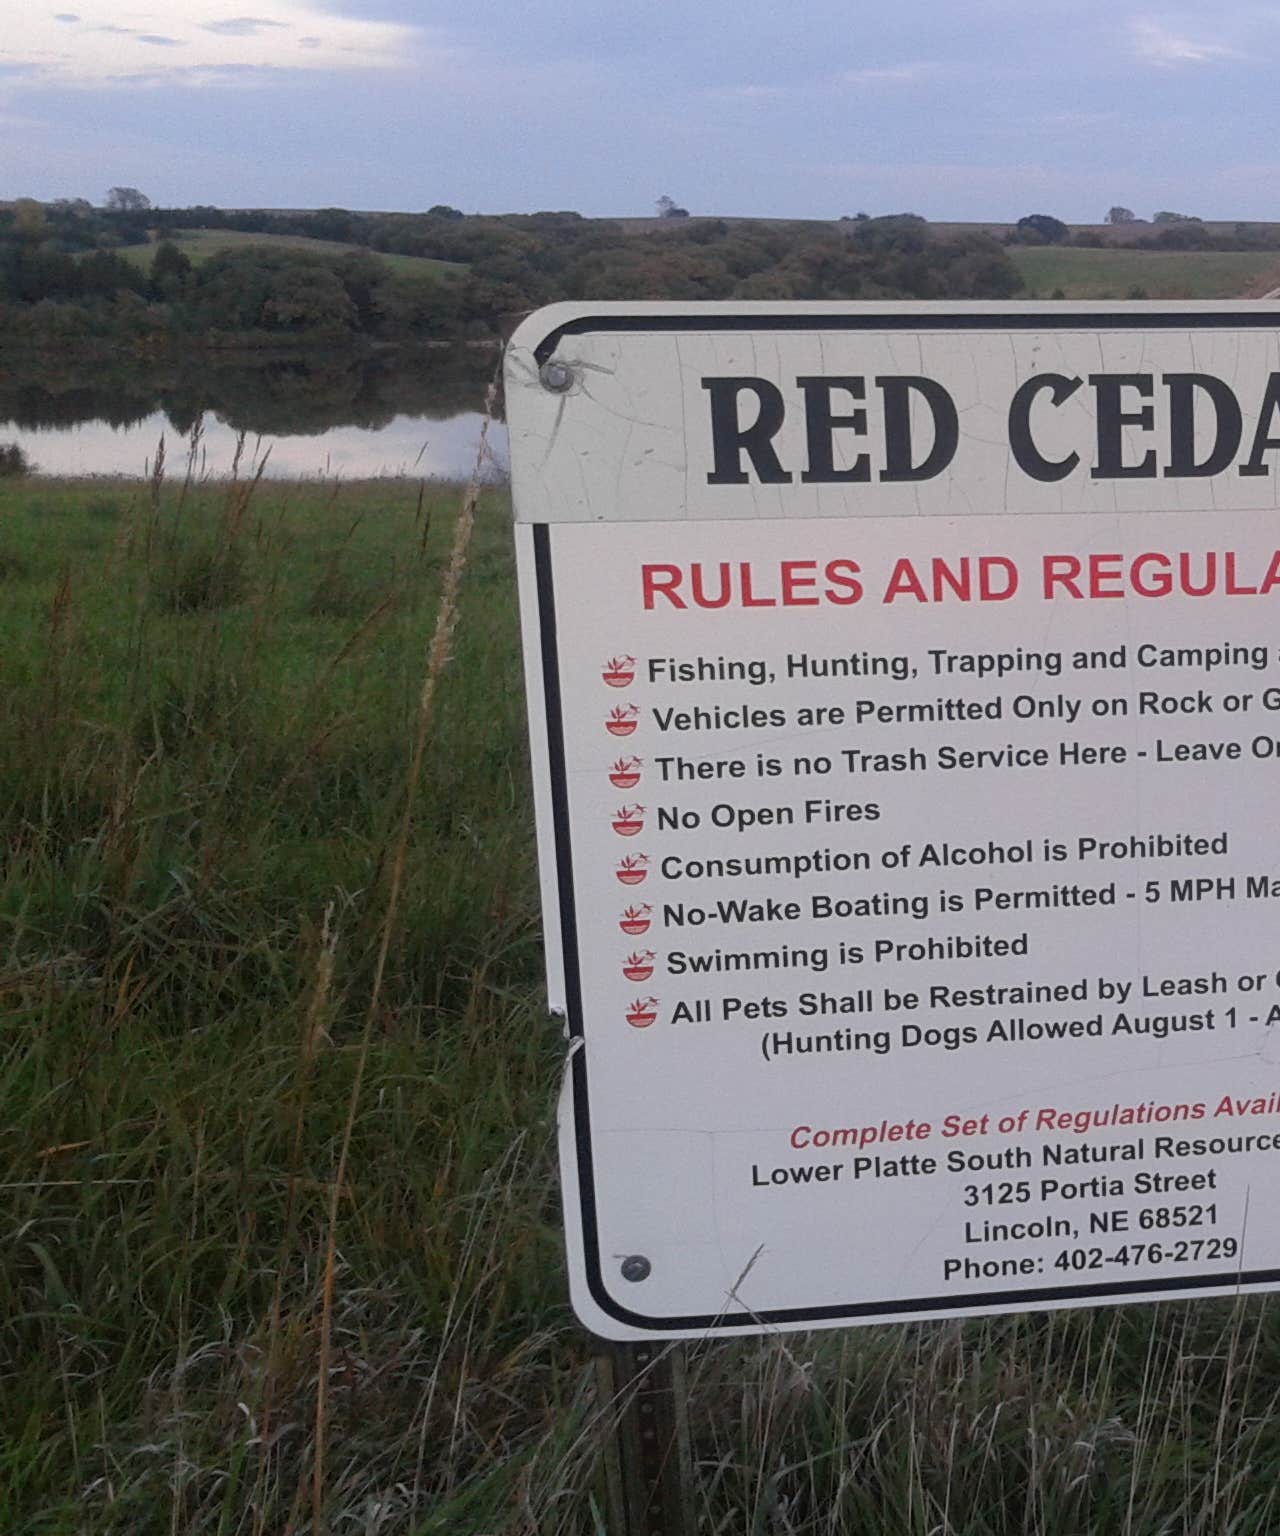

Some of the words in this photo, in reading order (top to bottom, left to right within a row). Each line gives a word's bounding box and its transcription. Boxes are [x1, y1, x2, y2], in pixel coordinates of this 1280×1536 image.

[700, 375, 960, 486] RED
[640, 558, 864, 611] RULES
[882, 556, 1019, 605] AND
[647, 655, 776, 686] Fishing,
[786, 650, 919, 681] Hunting,
[927, 646, 1063, 679] Trapping
[1071, 644, 1127, 670] and
[1136, 641, 1269, 673] Camping
[651, 703, 787, 732] Vehicles
[796, 706, 846, 727] are
[855, 695, 1003, 725] Permitted
[1012, 693, 1083, 724] Only
[1091, 697, 1129, 717] on
[1138, 689, 1214, 716] Rock
[1222, 693, 1254, 713] or
[653, 755, 747, 782] There
[756, 752, 783, 778] is
[793, 756, 833, 777] no
[840, 746, 928, 774] Trash
[937, 743, 1050, 770] Service
[1059, 741, 1128, 766] Here
[1155, 738, 1242, 763] Leave
[656, 805, 701, 832] No
[710, 803, 795, 833] Open
[803, 798, 881, 825] Fires
[660, 847, 871, 880] Consumption
[881, 843, 913, 869] of
[917, 839, 1033, 868] Alcohol
[1043, 838, 1069, 863] is
[1077, 831, 1228, 861] Prohibited
[663, 897, 802, 928] No-Wake
[811, 889, 929, 921] Boating
[938, 887, 965, 912] is
[973, 881, 1116, 913] Permitted
[1144, 880, 1161, 904] 5
[1170, 876, 1236, 903] MPH
[666, 944, 829, 975] Swimming
[838, 941, 865, 966] is
[874, 931, 1029, 966] Prohibited
[669, 998, 712, 1025] All
[721, 995, 789, 1022] Pets
[797, 988, 873, 1017] Shall
[883, 987, 920, 1012] be
[929, 977, 1088, 1009] Restrained
[1097, 976, 1133, 1005] by
[1142, 971, 1228, 998] Leash
[1236, 973, 1268, 993] or
[761, 1027, 891, 1063] (Hunting
[901, 1024, 979, 1052] Dogs
[985, 1013, 1103, 1043] Allowed
[1110, 1008, 1216, 1040] August
[1224, 1006, 1237, 1029] 1
[790, 1118, 932, 1151] Complete
[940, 1113, 990, 1138] Set
[997, 1109, 1031, 1134] of
[1035, 1100, 1207, 1134] Regulations
[751, 1163, 845, 1188] Lower
[853, 1153, 938, 1180] Platte
[946, 1145, 1032, 1173] South
[1042, 1137, 1145, 1168] Natural
[963, 1180, 1031, 1208] 3125
[1040, 1174, 1125, 1203] Portia
[1133, 1167, 1217, 1195] Street
[964, 1215, 1080, 1244] Lincoln,
[1089, 1209, 1130, 1235] NE
[1138, 1202, 1217, 1231] 68521
[943, 1256, 1044, 1282] Phone:
[1053, 1236, 1238, 1273] 402-476-2729
